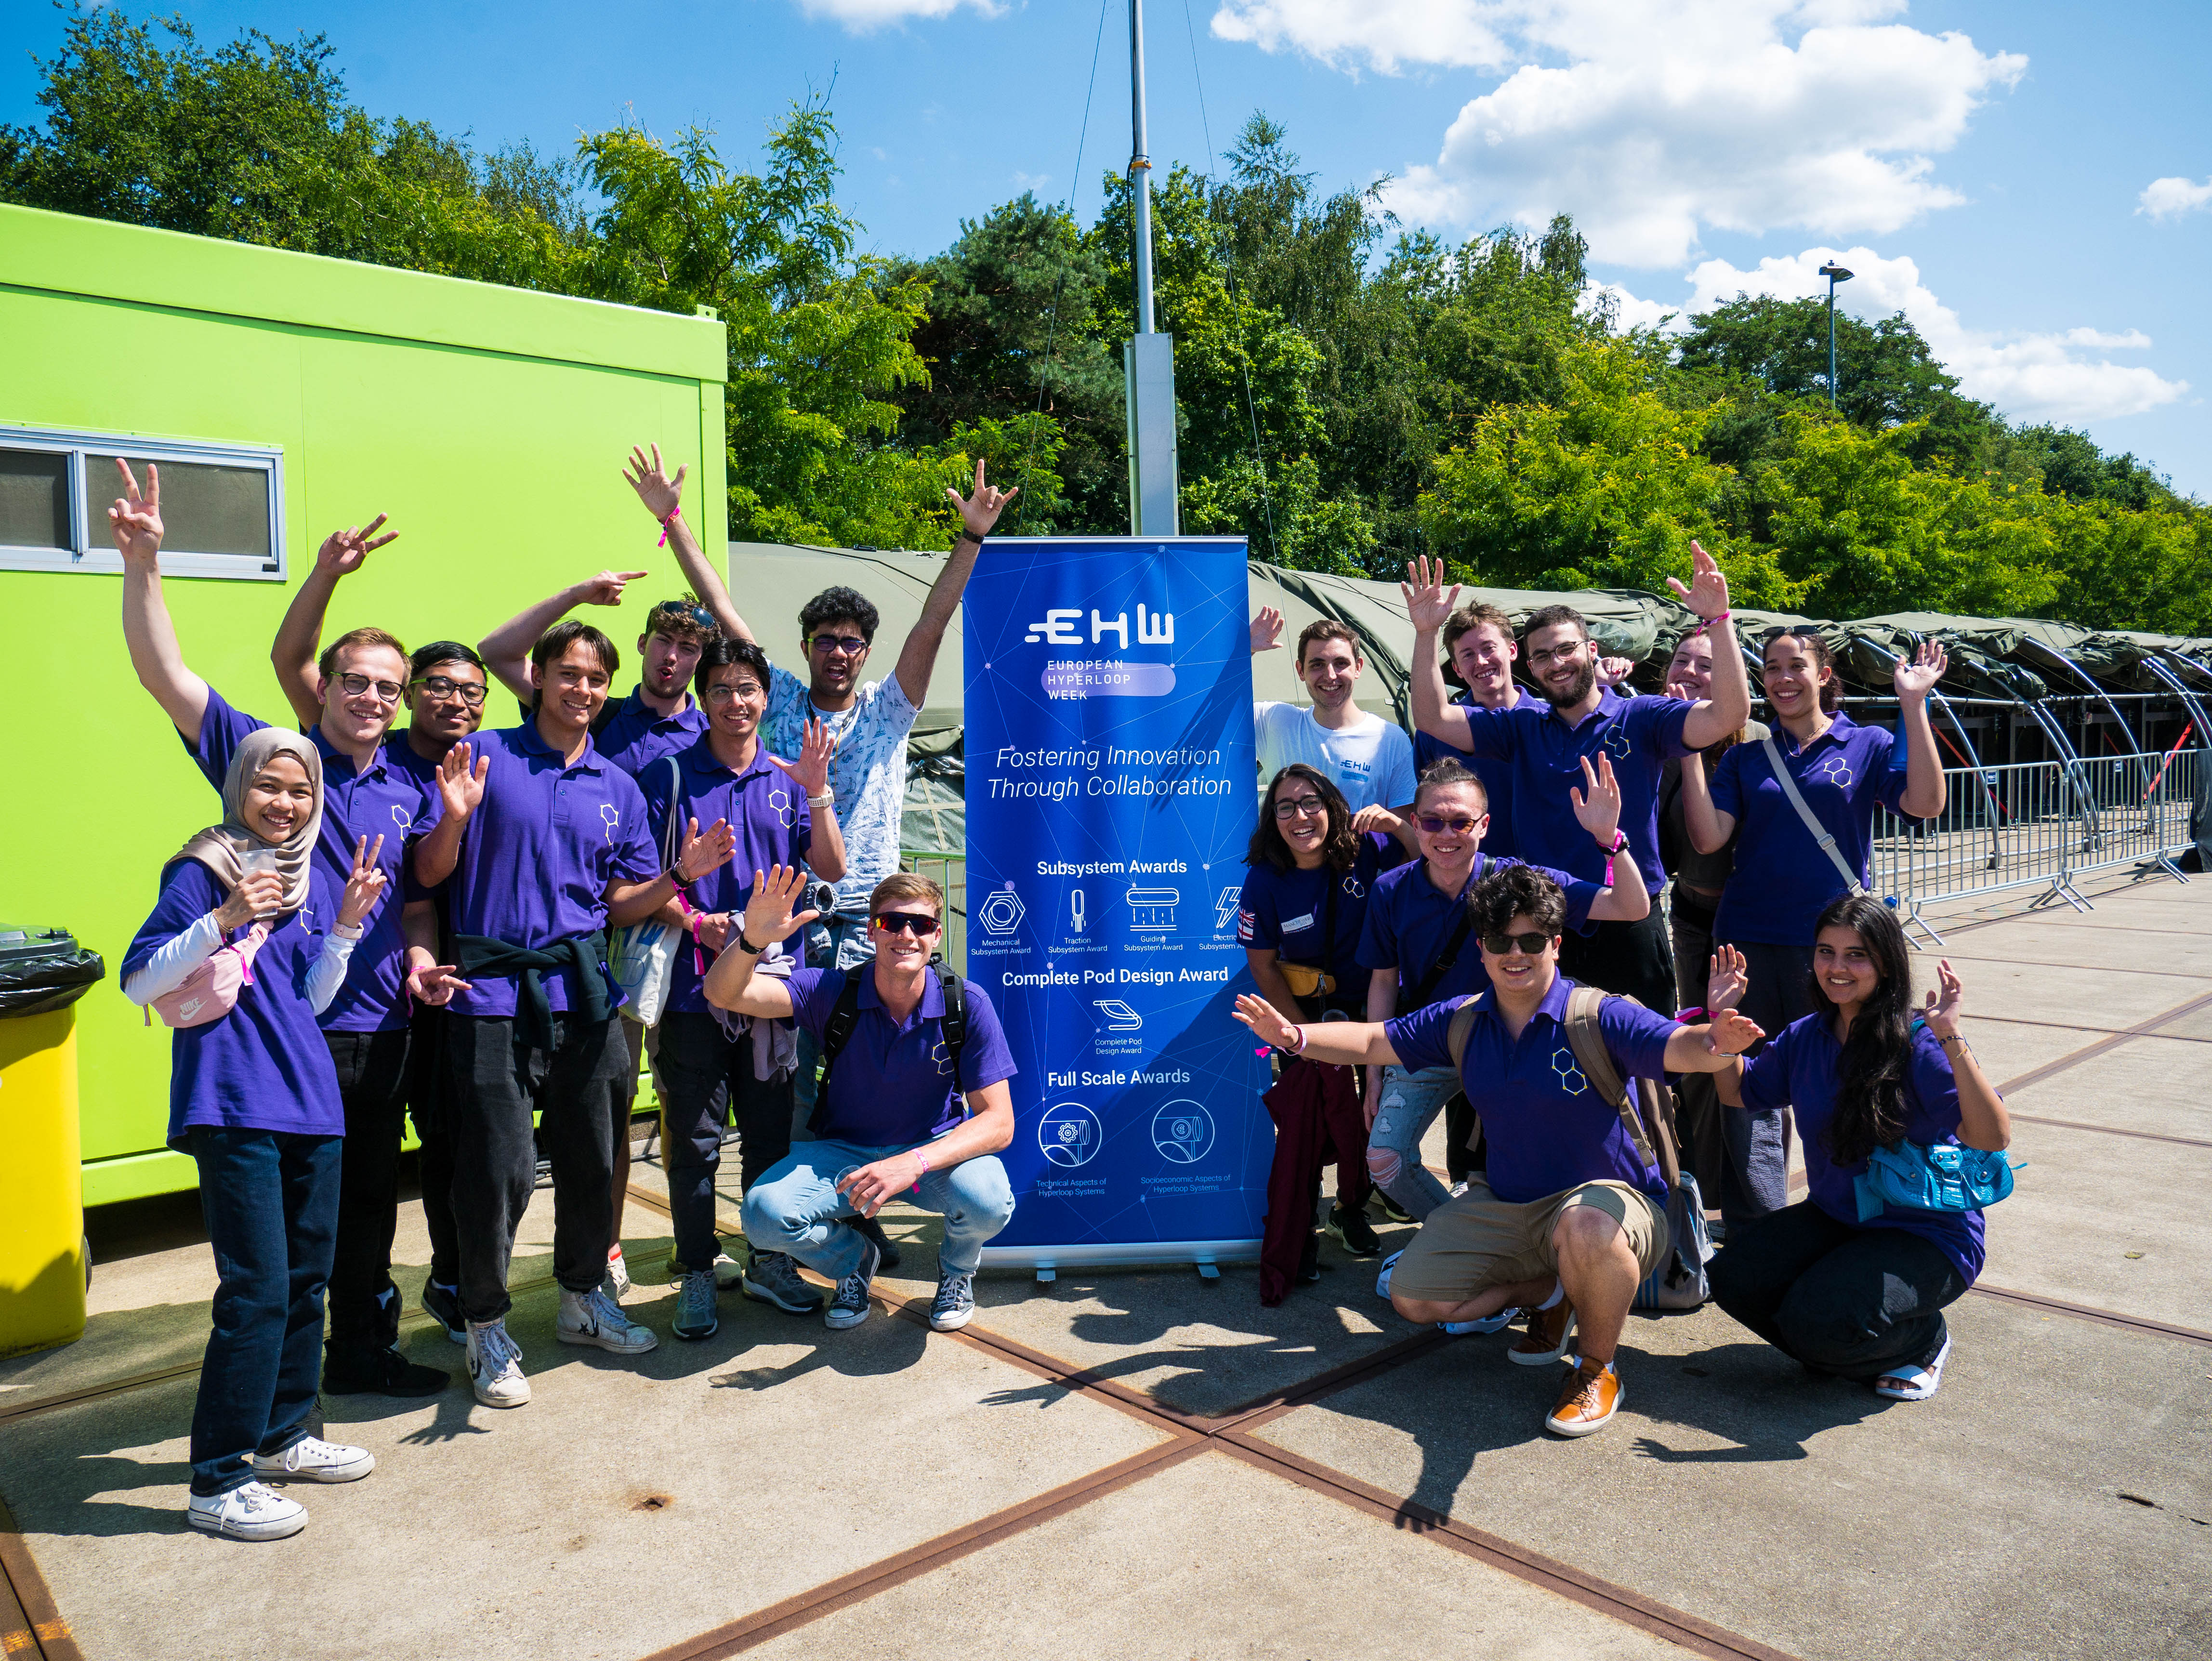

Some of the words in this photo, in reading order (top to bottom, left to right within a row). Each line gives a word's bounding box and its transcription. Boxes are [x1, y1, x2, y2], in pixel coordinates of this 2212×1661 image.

[1025, 603, 1174, 649] EHW
[1048, 659, 1123, 671] EUROPEAN
[1048, 674, 1131, 685] HYPERLOOP
[1048, 690, 1088, 700] WEEK
[997, 748, 1100, 770] Fostering
[1107, 745, 1220, 765] Innovation
[1340, 760, 1370, 772] EHW
[988, 777, 1079, 801] Through
[1087, 775, 1231, 795] Collaboration
[1037, 861, 1124, 878] Subsystem
[1129, 859, 1187, 873] Awards
[1283, 916, 1311, 928] MANCHESTER
[1140, 935, 1165, 943] Guiding
[971, 948, 1009, 956] Subsystem
[1048, 946, 1086, 954] Subsystem
[1124, 944, 1161, 952] Subsystem
[1002, 970, 1079, 989] Complete
[1084, 968, 1115, 983] Pod
[1120, 968, 1175, 986] Design
[1178, 967, 1228, 981] Award
[180, 997, 200, 1014] NIKE
[1095, 1039, 1127, 1047] Complete
[1048, 1070, 1076, 1086] Full
[1081, 1070, 1126, 1085] Scale
[1130, 1069, 1190, 1083] Awards
[1070, 1179, 1098, 1187] Aspects
[1141, 1176, 1193, 1184] Socioeconomic
[1195, 1174, 1222, 1183] Aspects
[1039, 1189, 1074, 1198] Hyperloop
[1154, 1185, 1188, 1193] Hyperloop
[1190, 1184, 1219, 1192] Systems
